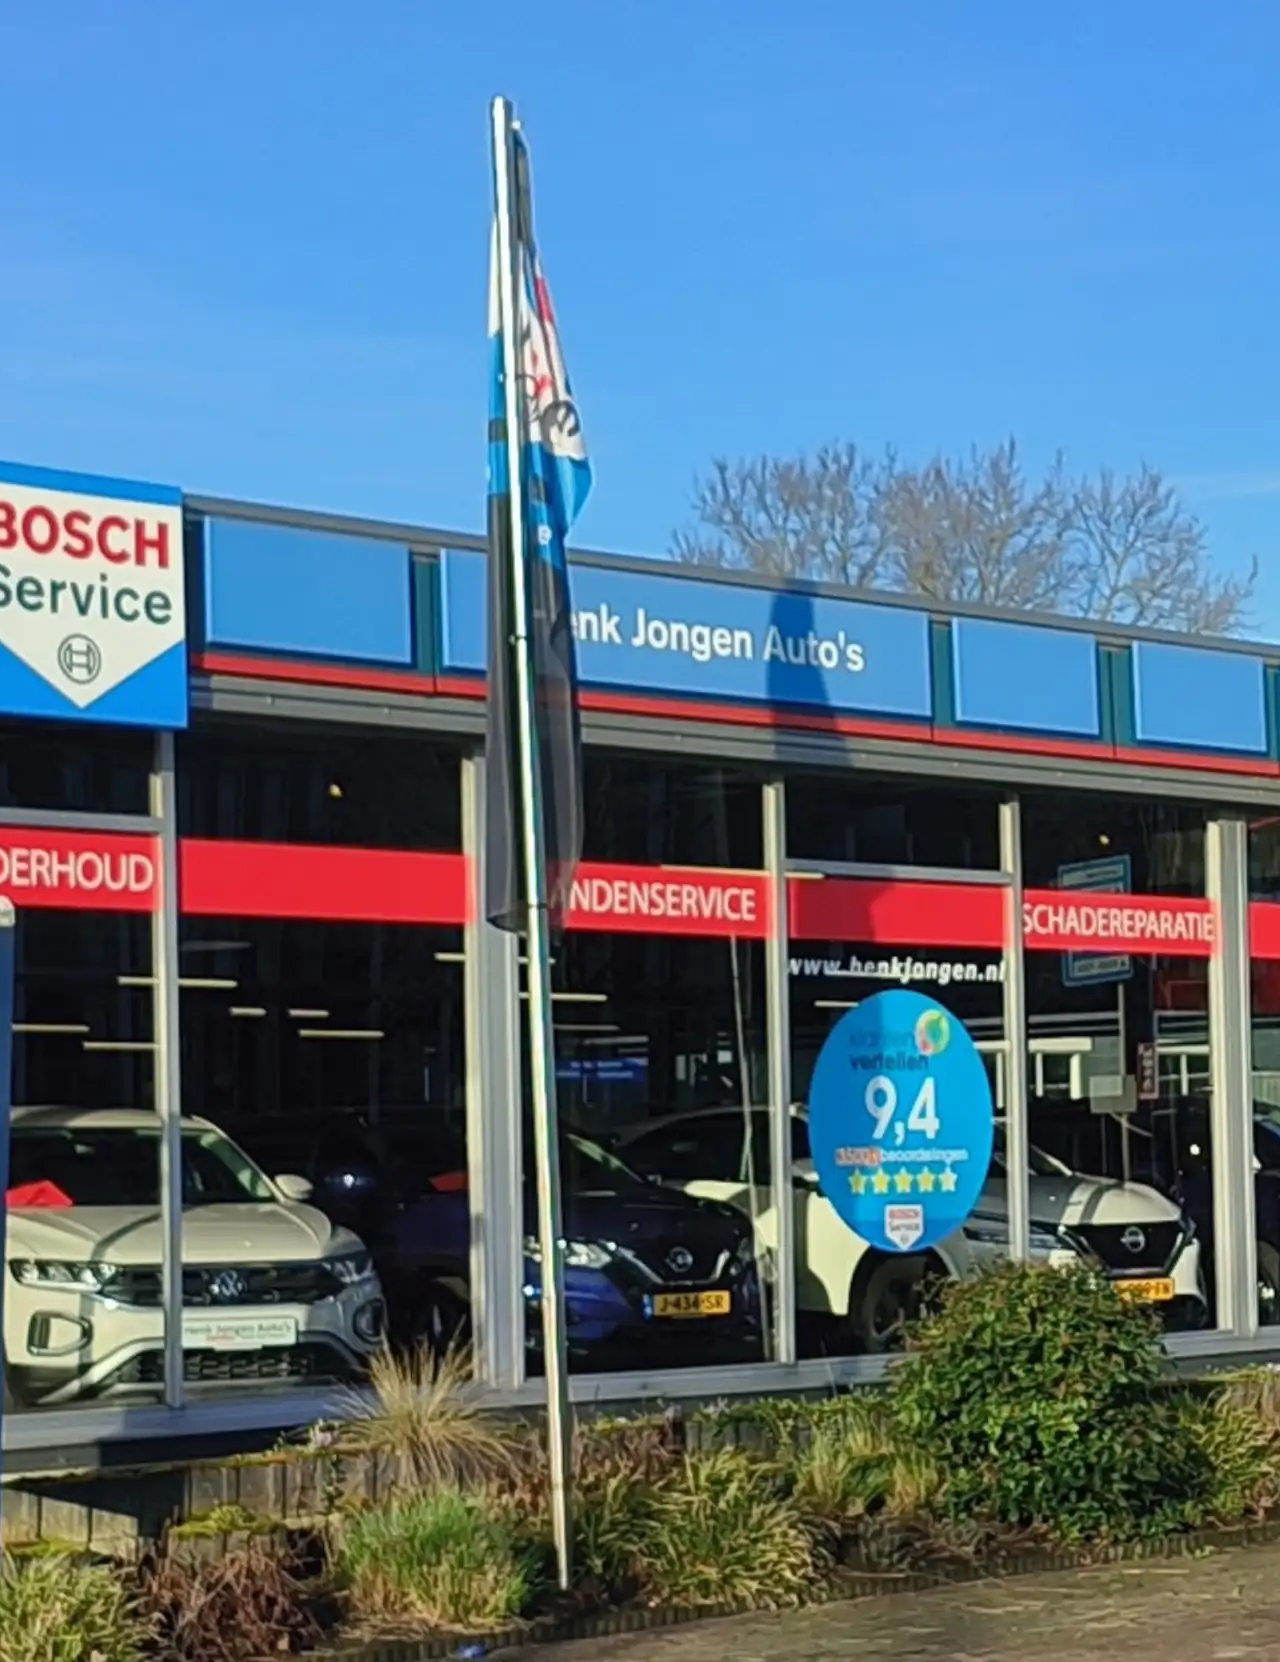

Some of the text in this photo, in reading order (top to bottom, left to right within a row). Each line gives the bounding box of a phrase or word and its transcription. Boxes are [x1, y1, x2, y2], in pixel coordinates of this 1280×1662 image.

[631, 607, 754, 662] Jongen
[762, 625, 865, 671] Auto's
[1023, 902, 1216, 941] SCHADEREPARATIE
[864, 1074, 940, 1147] 9,4
